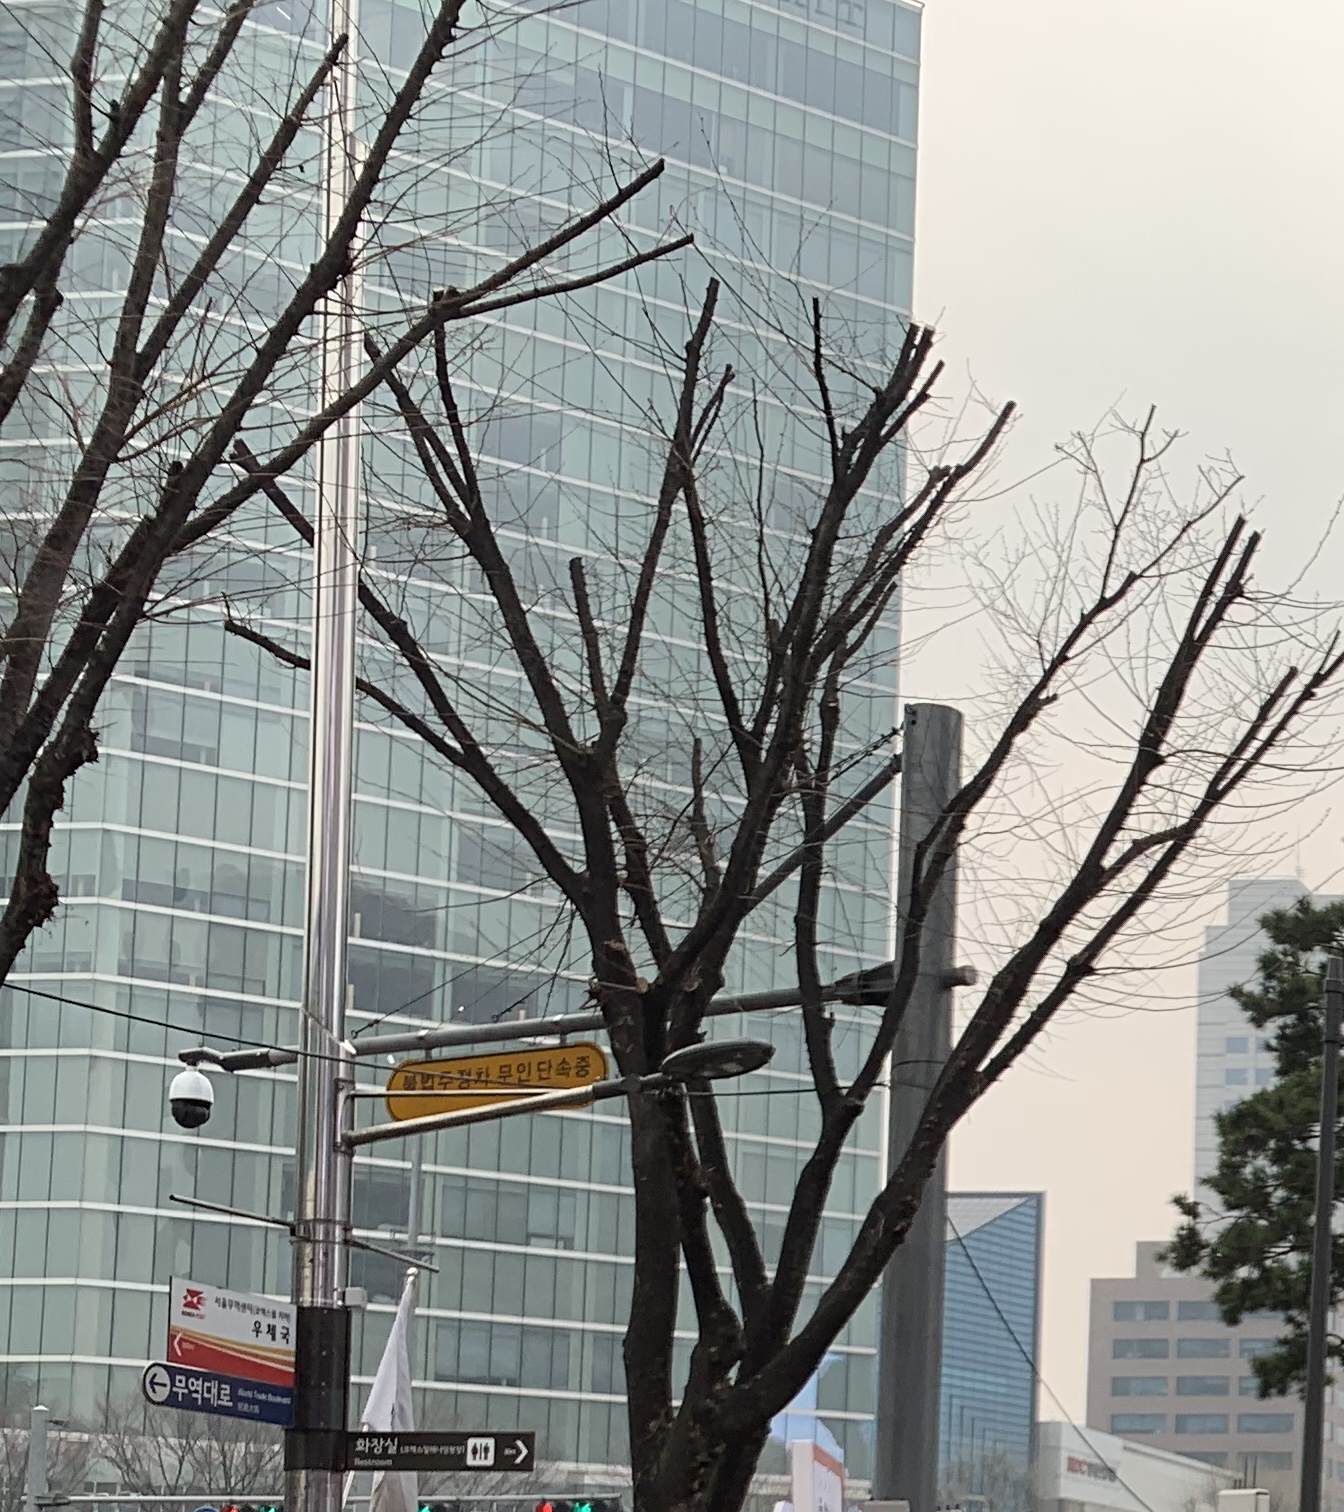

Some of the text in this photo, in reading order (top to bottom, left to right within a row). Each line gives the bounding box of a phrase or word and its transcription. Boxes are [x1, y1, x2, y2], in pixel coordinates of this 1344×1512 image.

[252, 1320, 291, 1345] 우체국
[172, 1374, 233, 1407] 무역대로
[355, 1437, 398, 1454] 화장실
